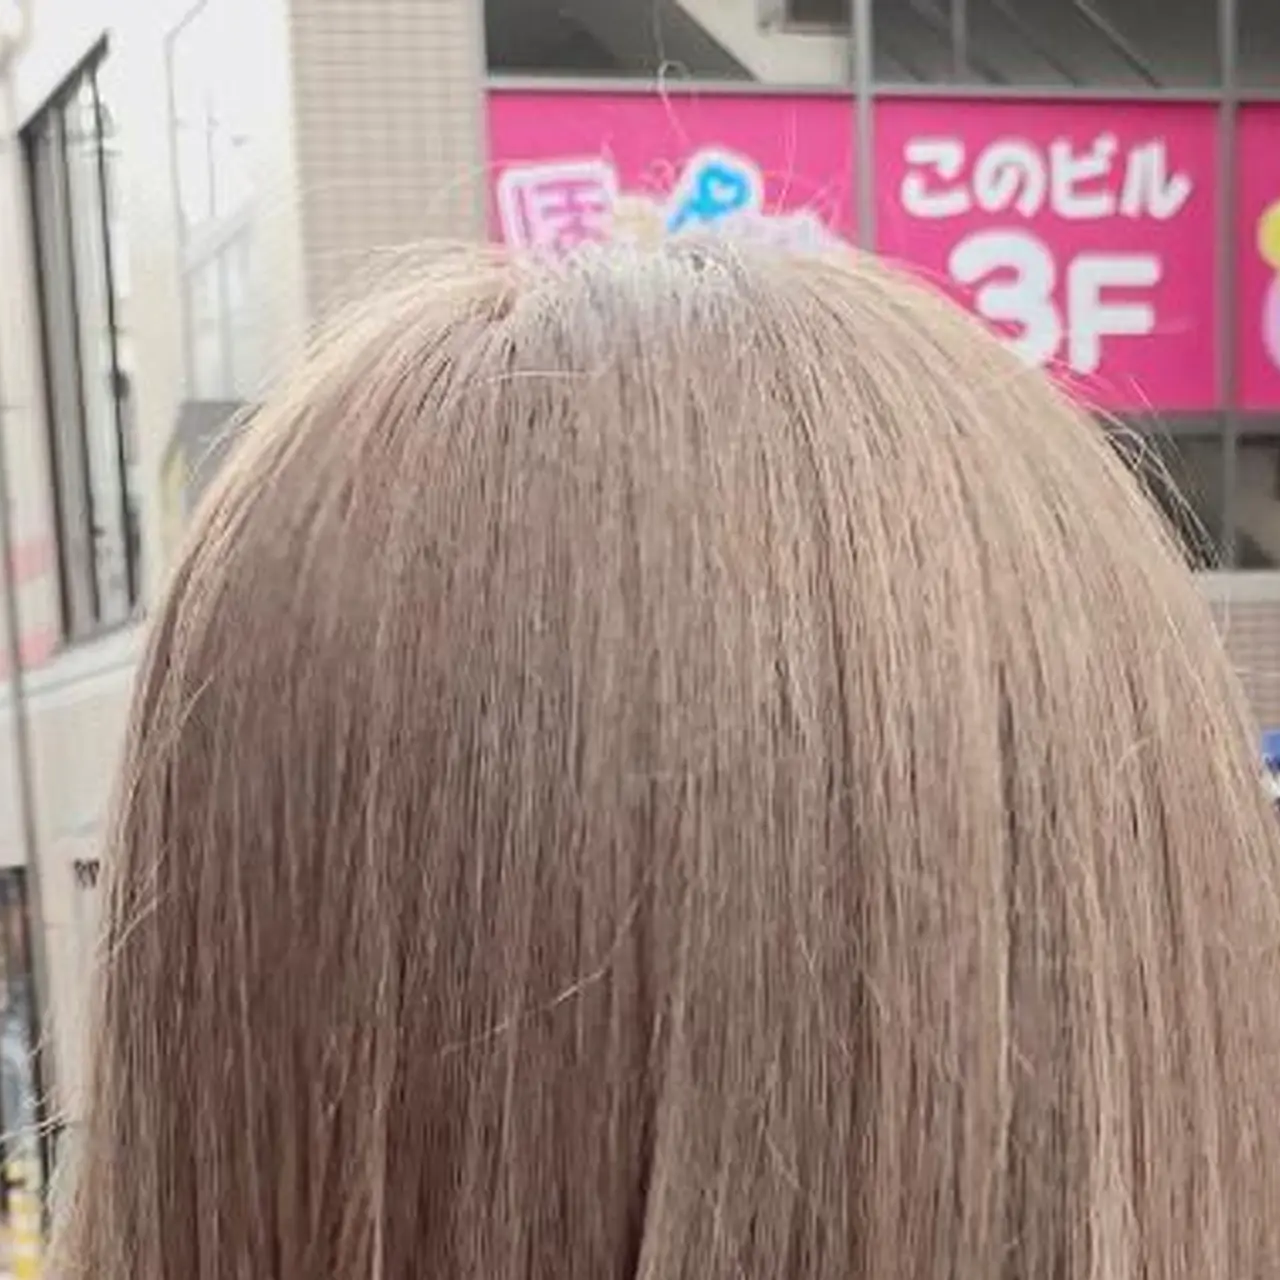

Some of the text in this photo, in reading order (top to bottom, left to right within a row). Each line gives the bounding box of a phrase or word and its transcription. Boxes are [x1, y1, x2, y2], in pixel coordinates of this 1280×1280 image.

[902, 136, 1191, 219] このビル
[950, 231, 1160, 371] 3F
